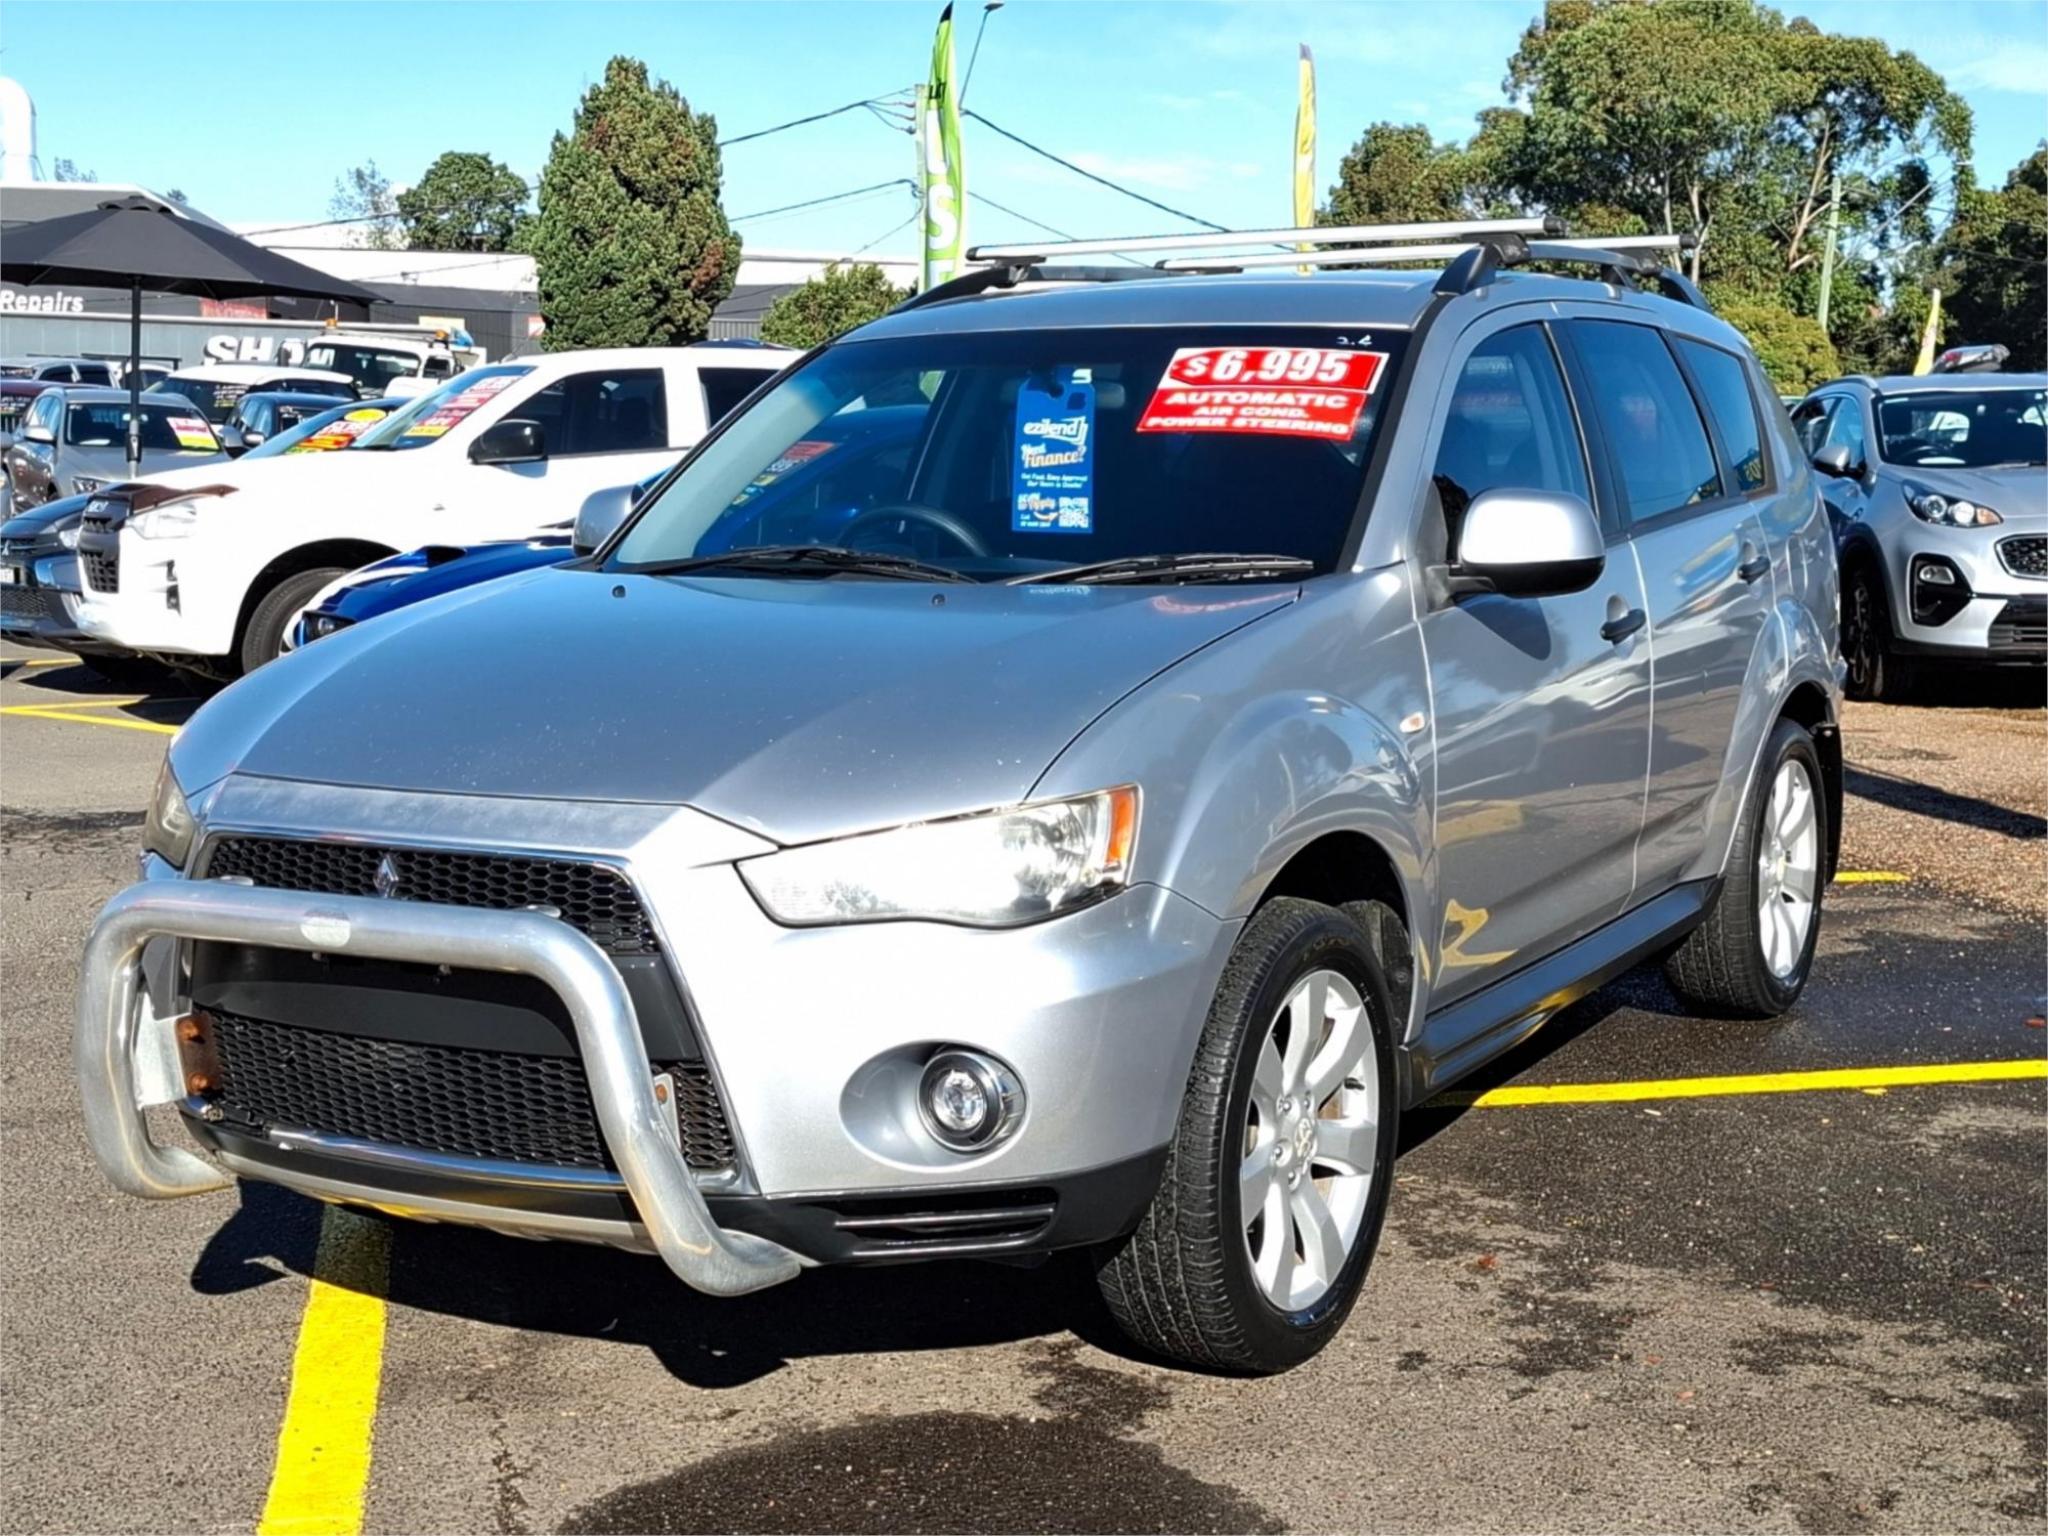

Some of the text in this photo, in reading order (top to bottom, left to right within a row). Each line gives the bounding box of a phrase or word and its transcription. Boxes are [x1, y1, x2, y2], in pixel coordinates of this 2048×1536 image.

[0, 289, 84, 312] Repairs
[1184, 349, 1353, 383] $6,995
[1164, 391, 1349, 409] AUTOMATIC
[1193, 406, 1235, 417] AIR
[1145, 416, 1350, 435] POWER STEERING
